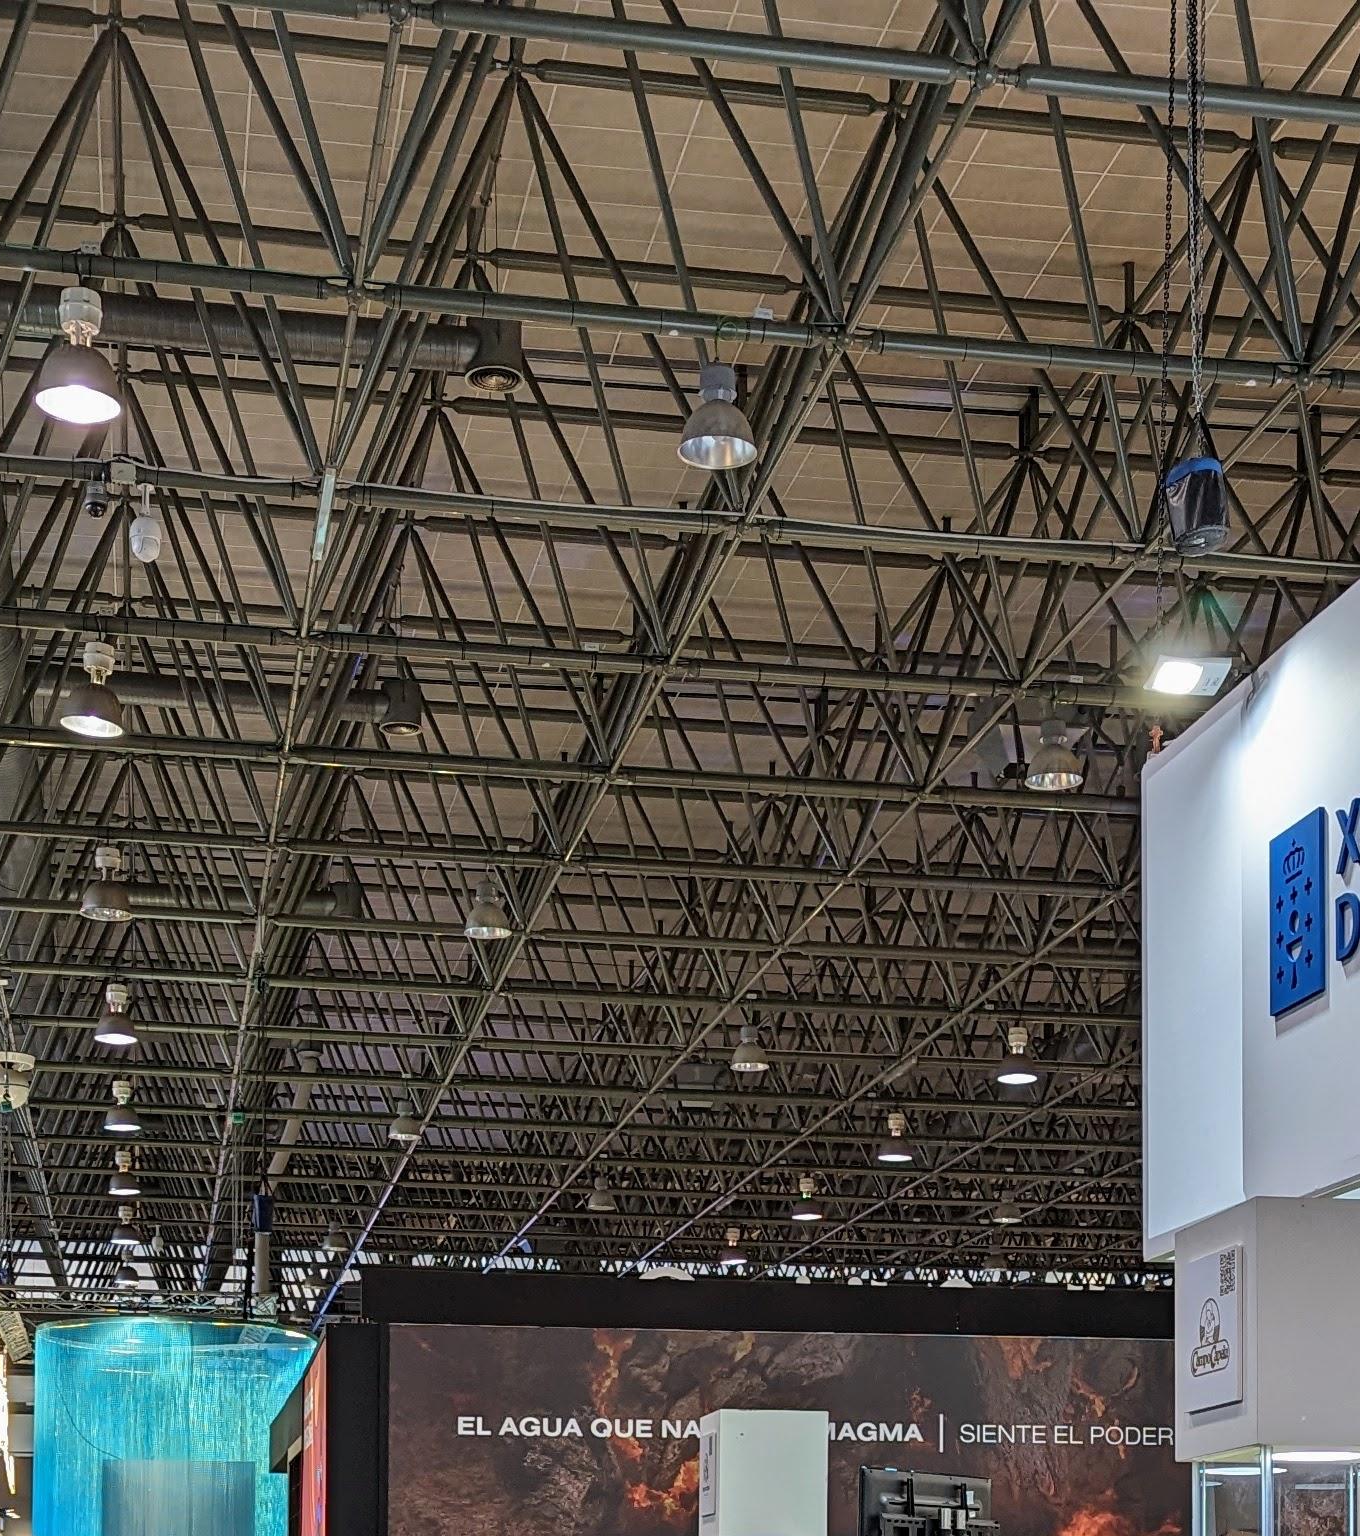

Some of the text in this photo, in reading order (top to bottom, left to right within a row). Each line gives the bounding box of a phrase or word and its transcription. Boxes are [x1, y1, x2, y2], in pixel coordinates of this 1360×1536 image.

[457, 1416, 492, 1436] EL
[498, 1416, 584, 1438] AGUA
[590, 1418, 653, 1439] QUE
[959, 1423, 1047, 1444] SIENTE
[1054, 1425, 1084, 1445] EL
[1090, 1425, 1174, 1446] PODER
